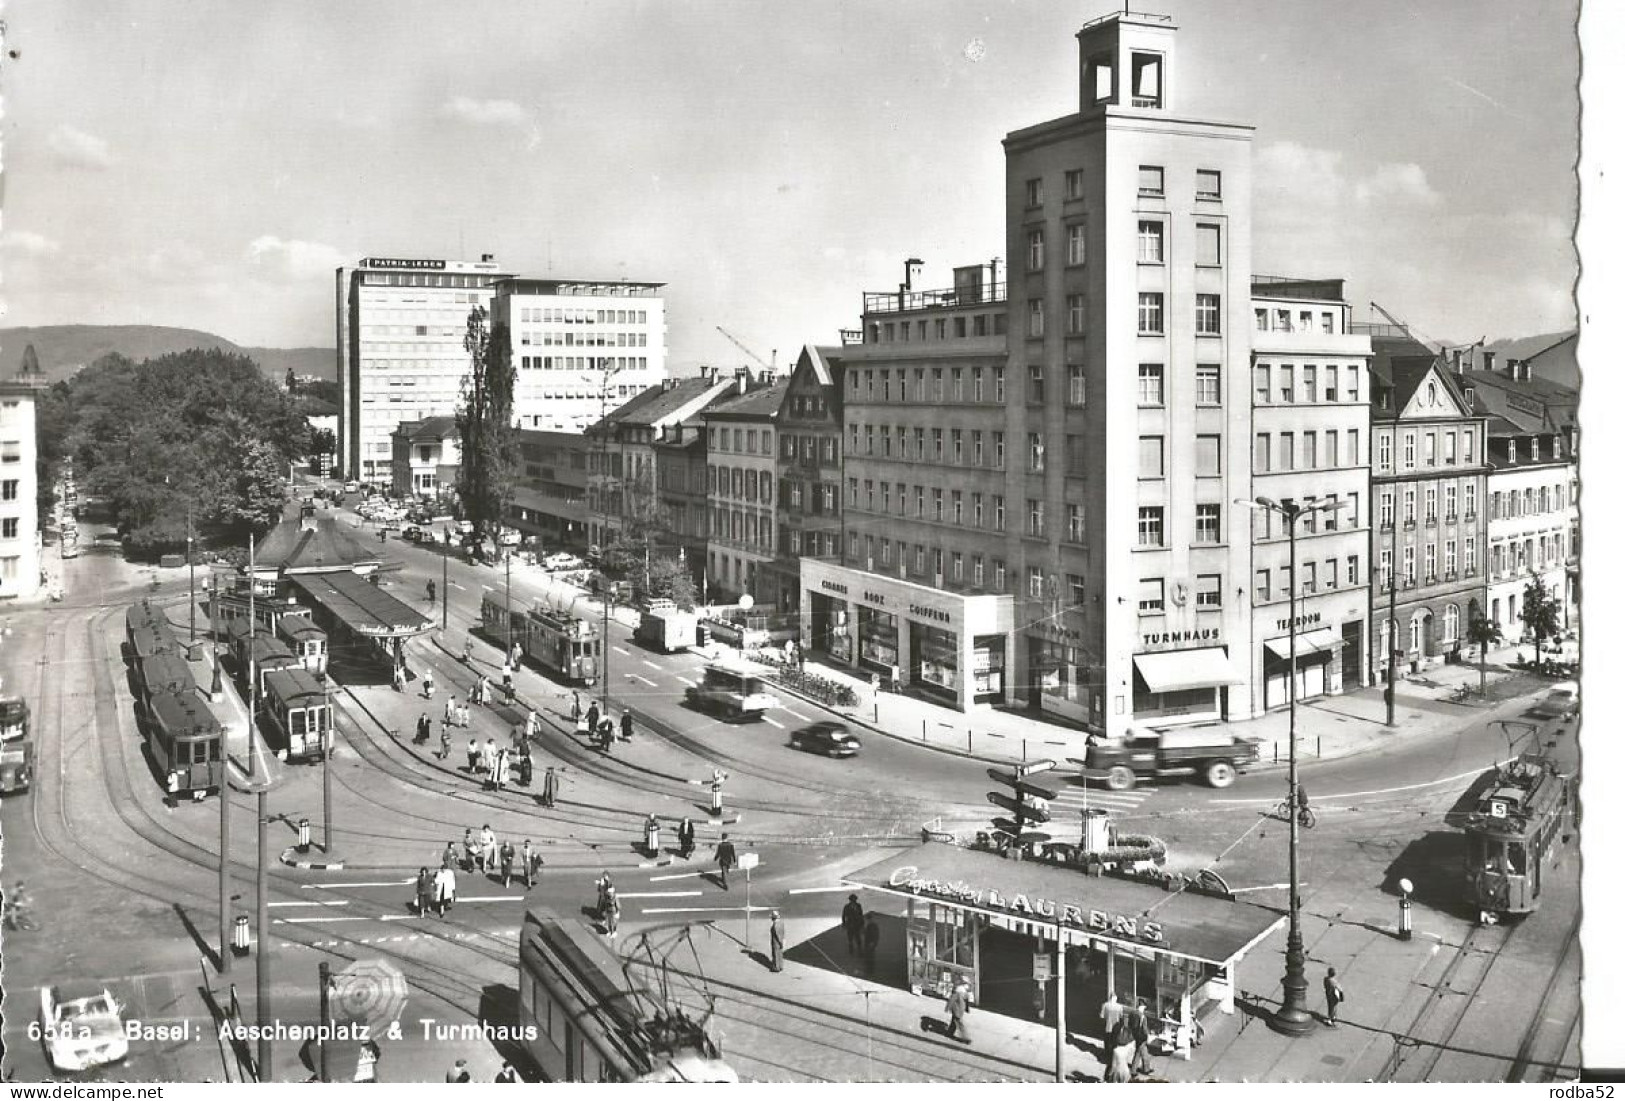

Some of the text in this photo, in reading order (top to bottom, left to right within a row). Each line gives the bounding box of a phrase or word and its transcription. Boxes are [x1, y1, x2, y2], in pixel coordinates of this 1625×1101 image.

[909, 603, 950, 624] COIFFEUR
[1144, 628, 1220, 645] TURMHAUS
[1495, 804, 1504, 815] 5
[989, 890, 1162, 942] LAURENS
